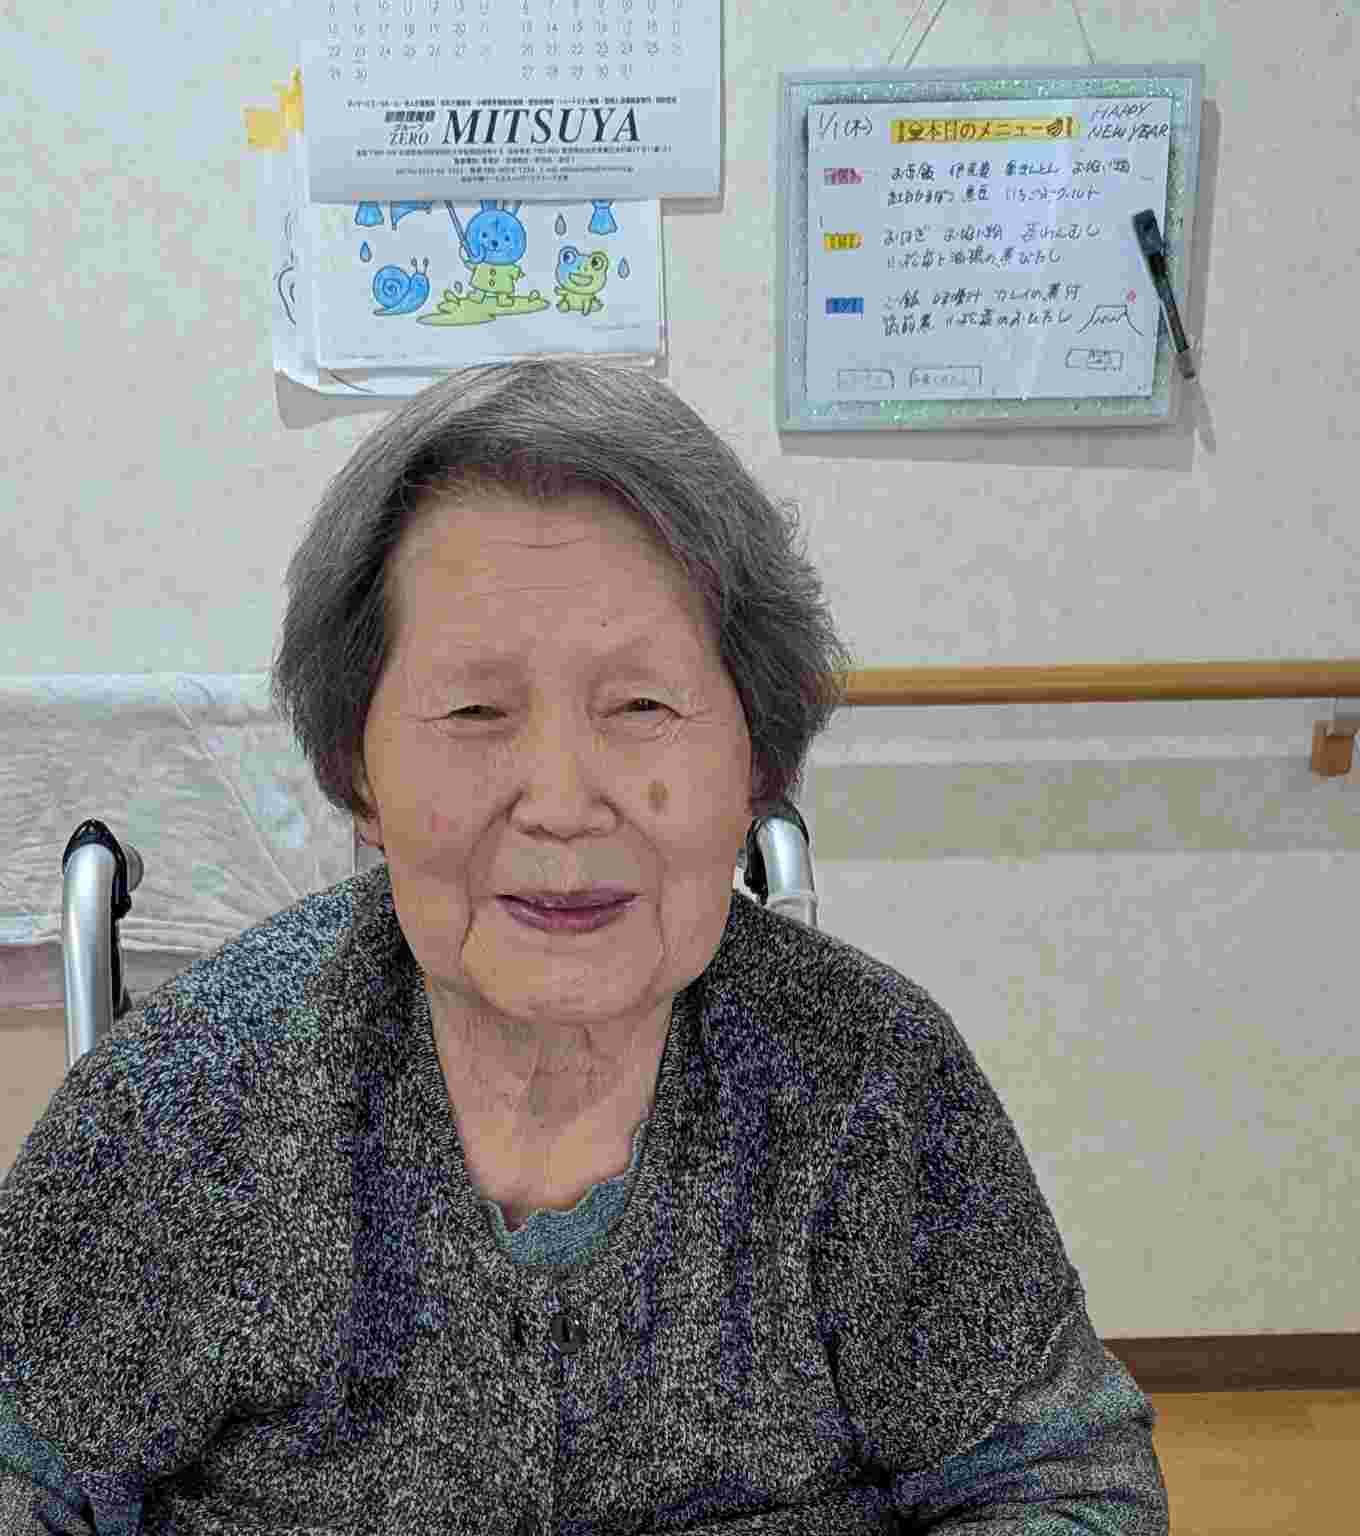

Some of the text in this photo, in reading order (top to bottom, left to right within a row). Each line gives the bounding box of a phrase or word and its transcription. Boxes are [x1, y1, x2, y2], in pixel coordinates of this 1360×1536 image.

[1090, 102, 1152, 121] HAPPY
[441, 107, 642, 145] MITSUYA
[1086, 123, 1170, 143] NEW YEAR
[388, 132, 431, 147] ZERO
